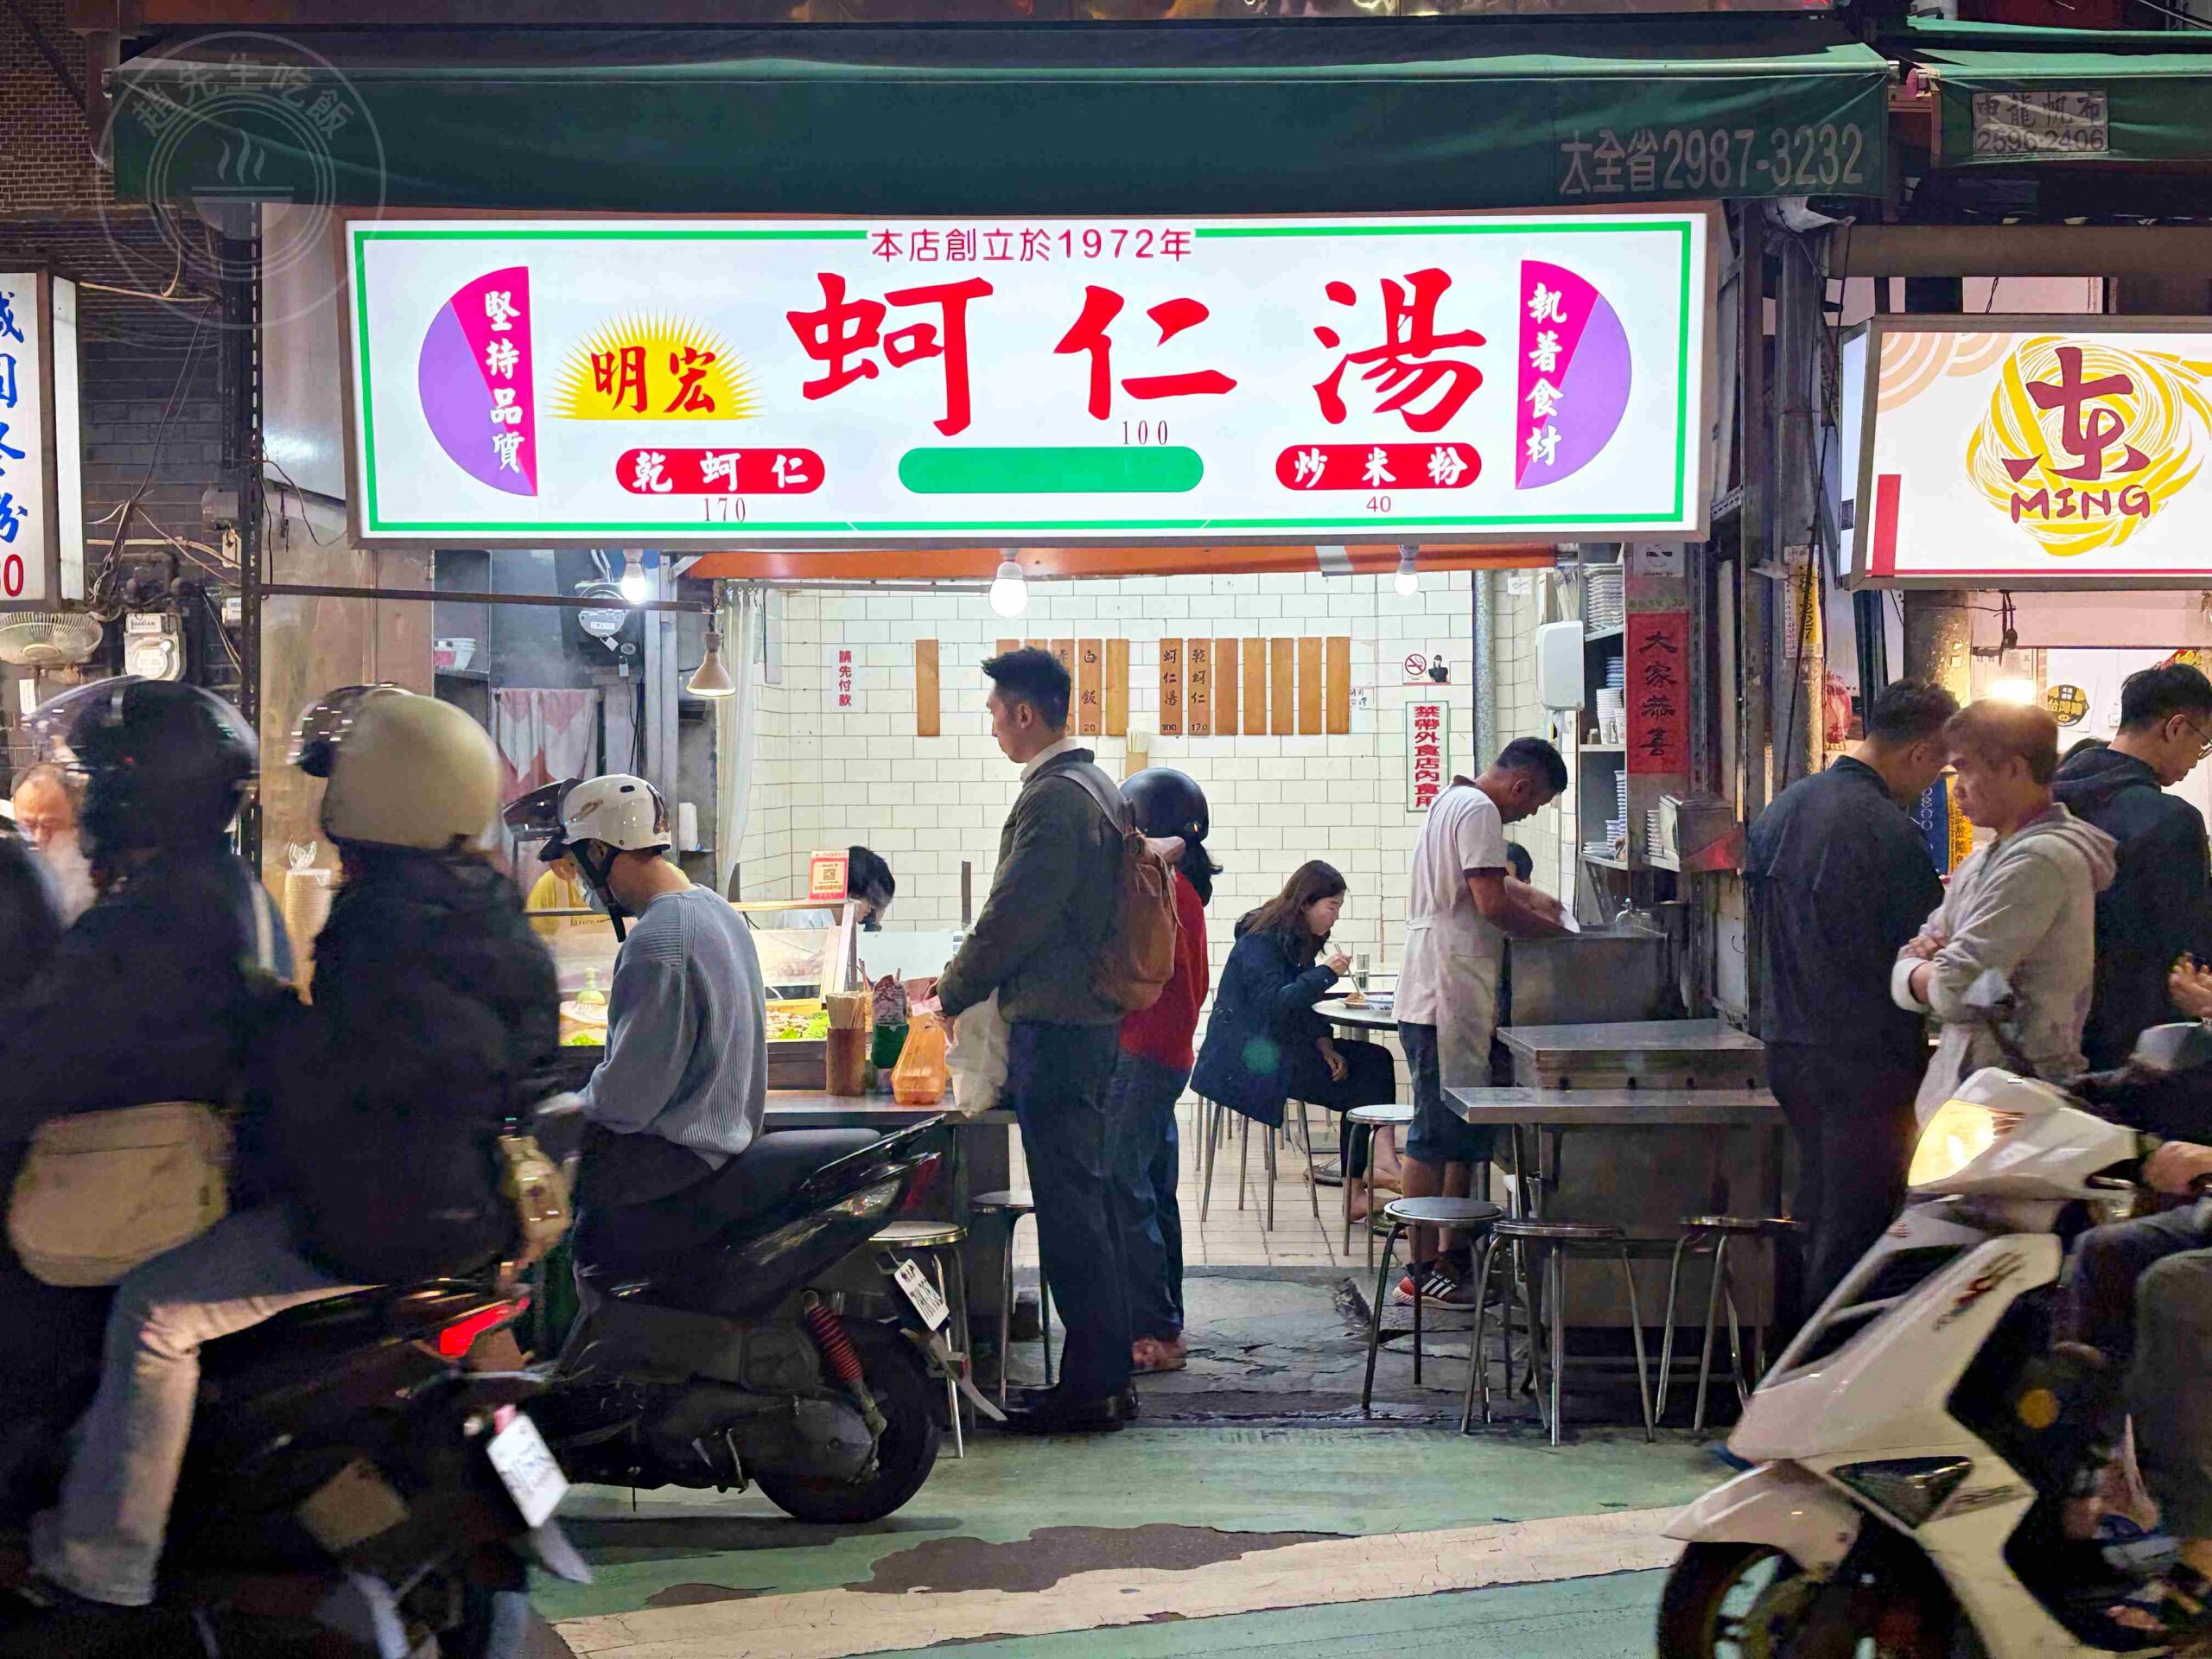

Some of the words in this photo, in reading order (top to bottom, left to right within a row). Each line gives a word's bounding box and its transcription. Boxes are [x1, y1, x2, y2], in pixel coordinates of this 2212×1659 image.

[871, 228, 1192, 262] 本店創立於1972年
[785, 269, 1487, 436] 蚵仁湯
[485, 291, 524, 474] 堅持品質
[591, 346, 716, 413] 明宏
[1122, 420, 1168, 445] 100
[632, 450, 809, 493] 乾蚵仁
[1294, 446, 1469, 487] 炒米粉
[702, 497, 747, 524] 170
[1365, 496, 1392, 512] 40
[2011, 486, 2151, 524] MING
